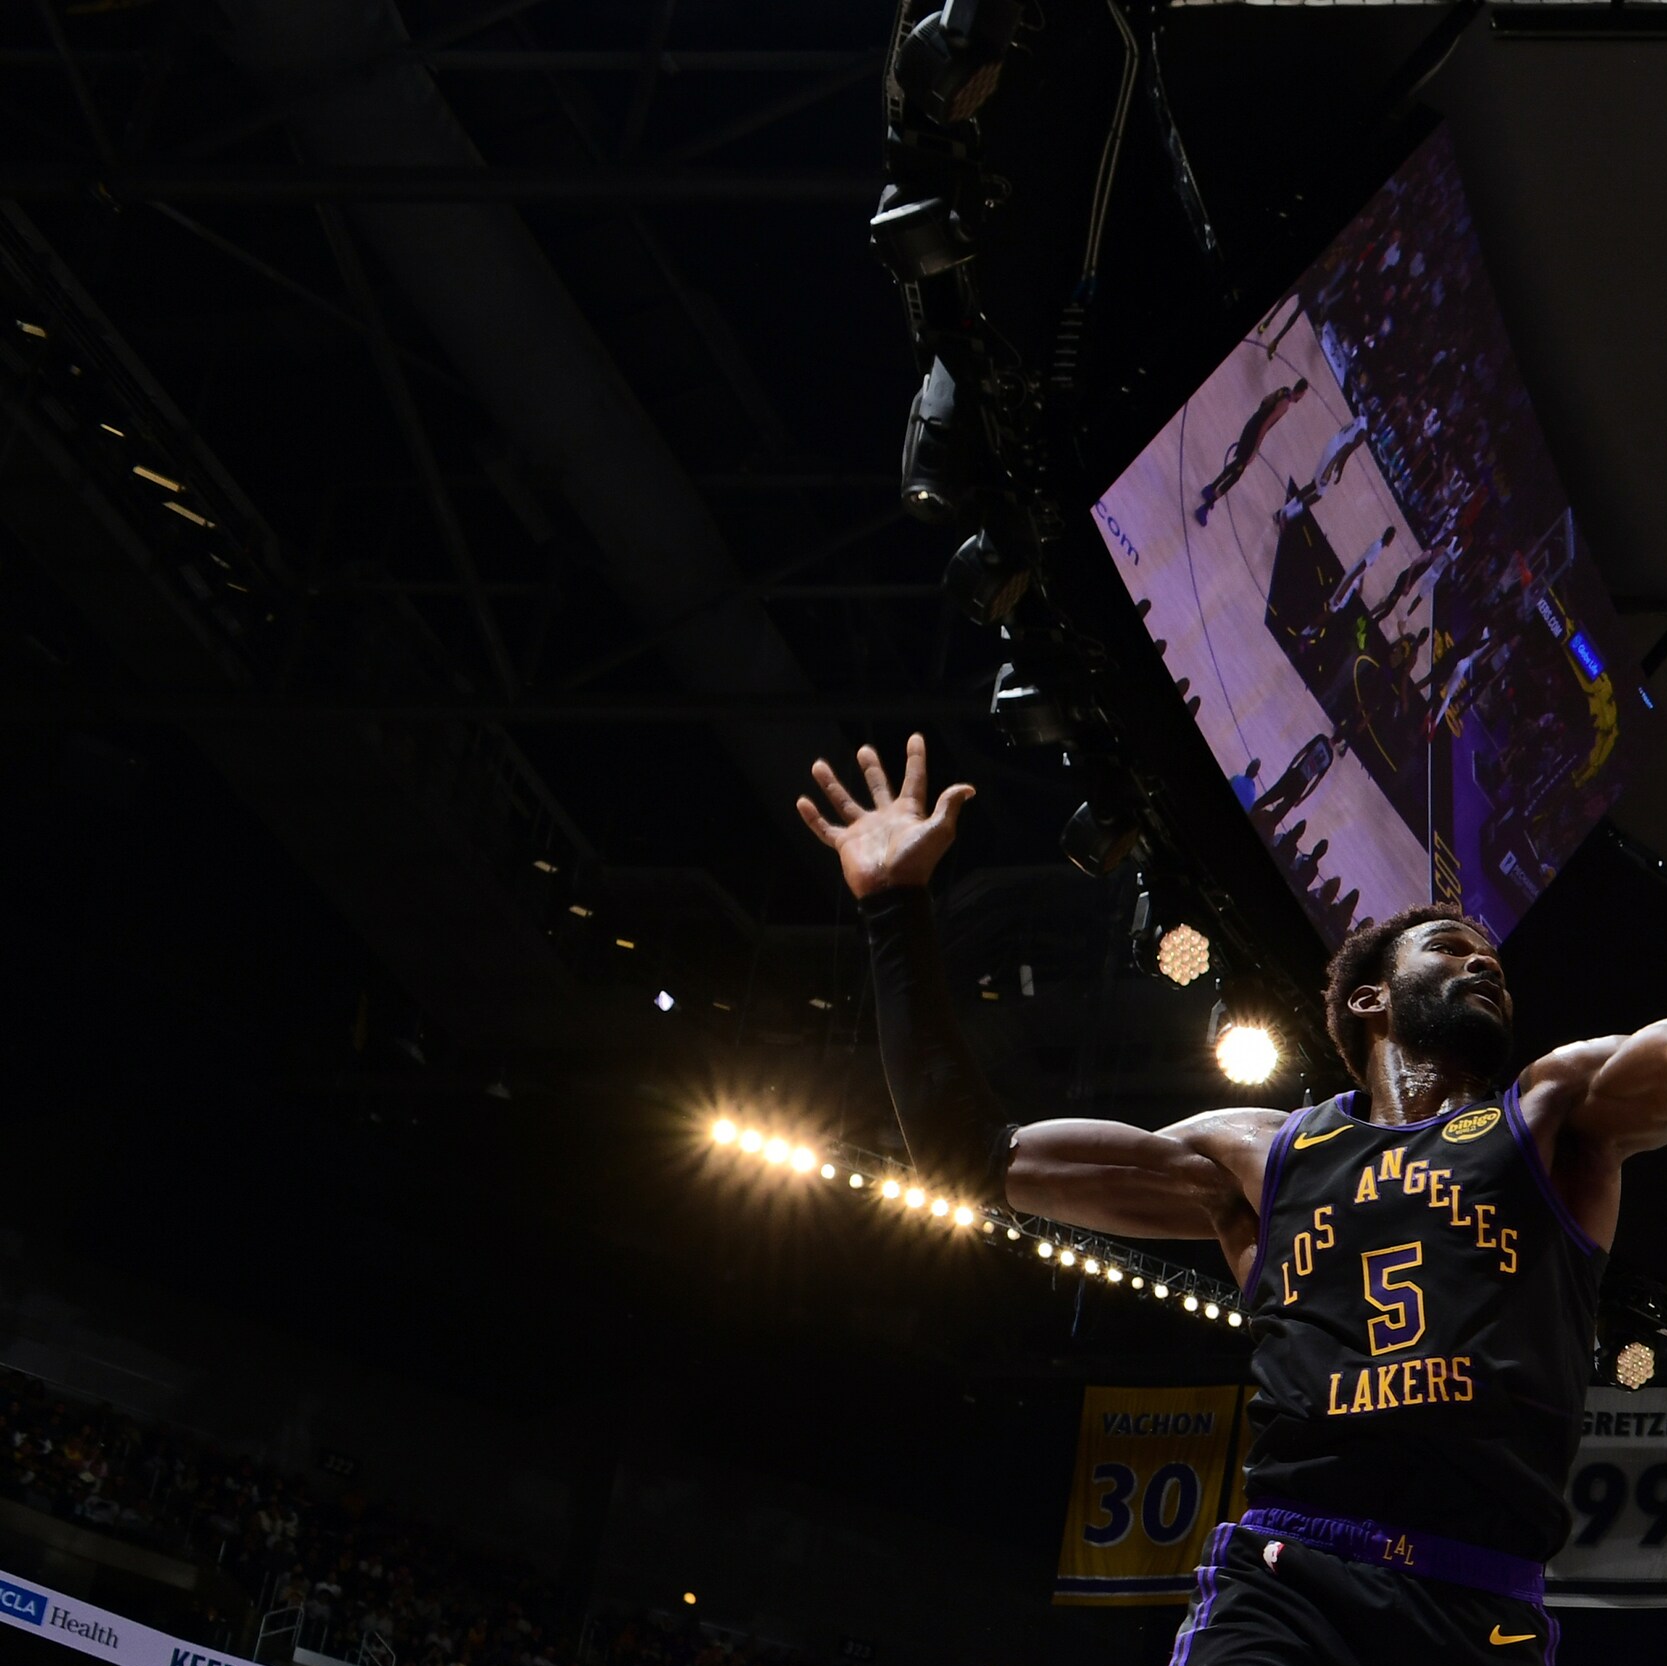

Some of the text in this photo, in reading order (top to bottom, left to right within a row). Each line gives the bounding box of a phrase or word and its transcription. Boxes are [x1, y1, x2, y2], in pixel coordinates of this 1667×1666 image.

[1449, 1113, 1497, 1132] bibigo
[1281, 1148, 1518, 1305] LOS ANGELES
[1362, 1240, 1427, 1356] 5
[1328, 1355, 1473, 1416] LAKERS
[1103, 1412, 1213, 1437] VACHON
[1083, 1461, 1202, 1546] 30
[1383, 1534, 1415, 1567] LAL
[49, 1605, 120, 1649] Health
